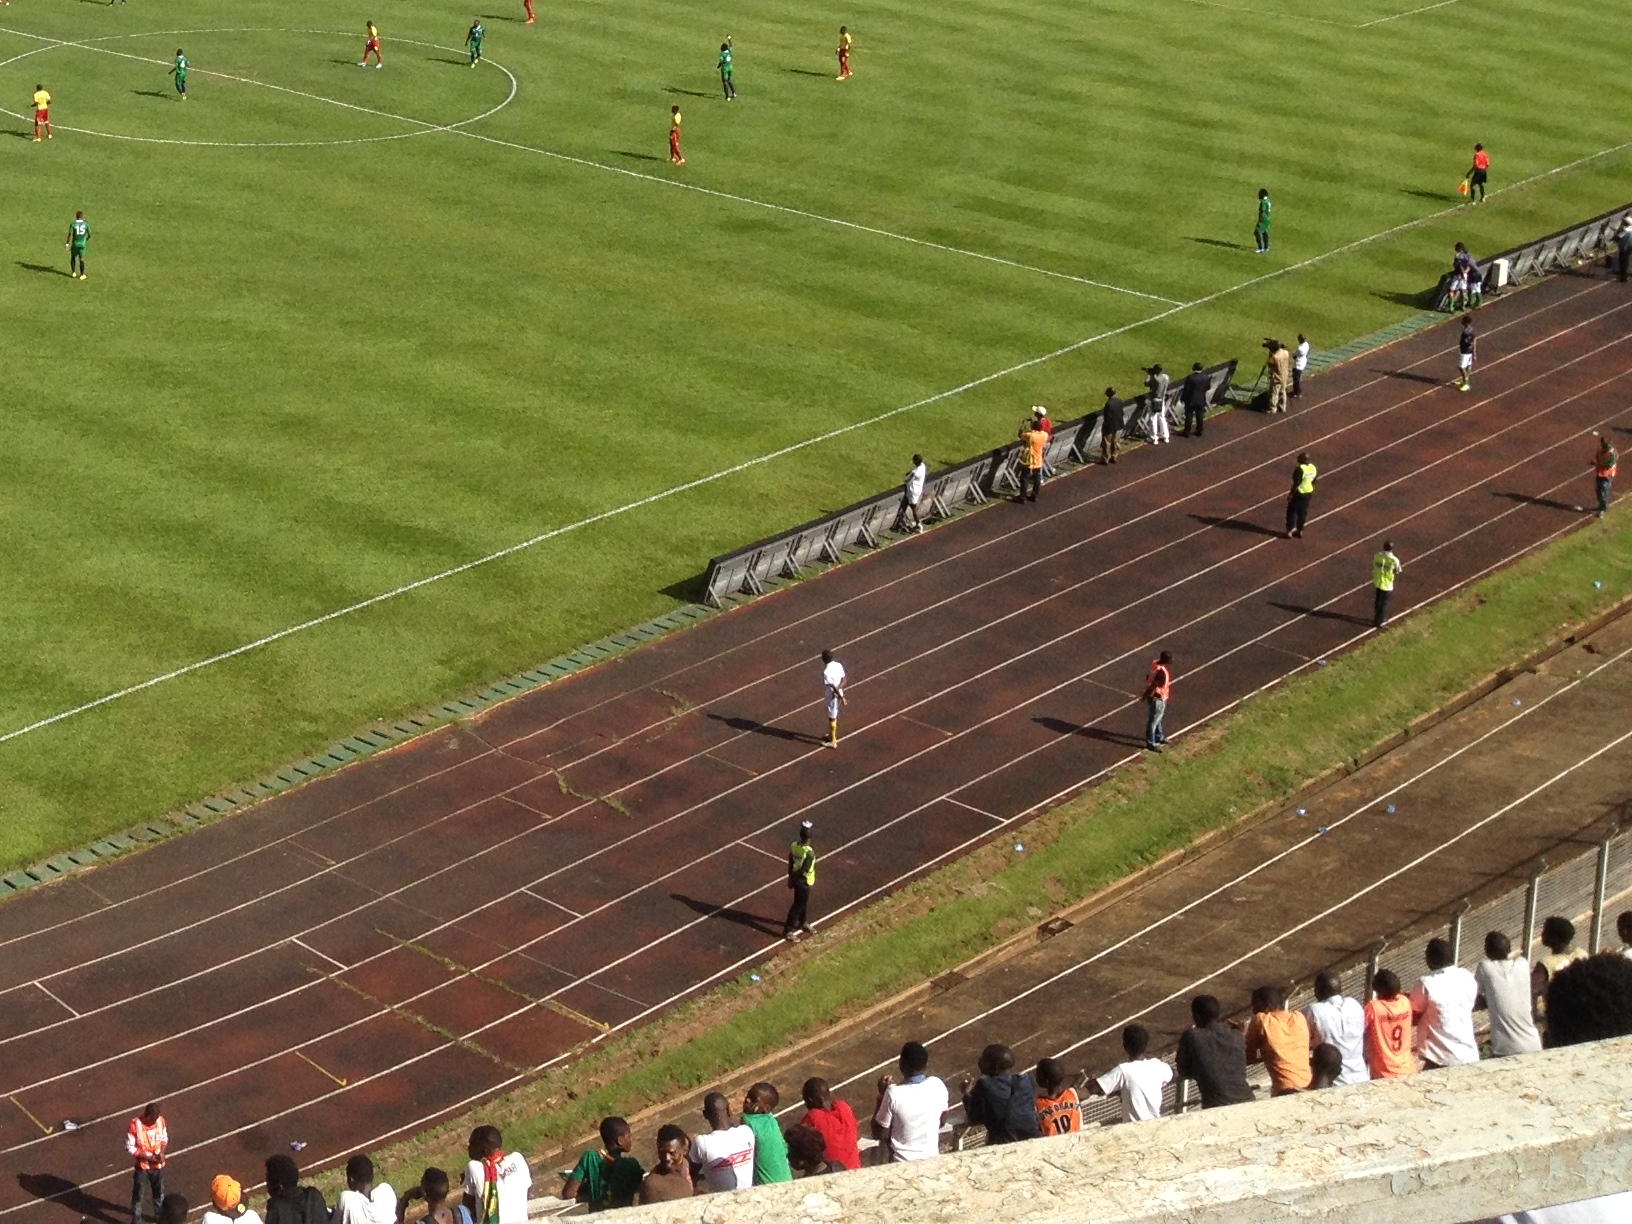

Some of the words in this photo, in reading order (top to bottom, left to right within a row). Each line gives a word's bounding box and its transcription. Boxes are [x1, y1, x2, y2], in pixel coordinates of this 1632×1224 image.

[74, 224, 86, 235] 15
[1391, 1024, 1403, 1053] 9
[1052, 1114, 1071, 1134] 10
